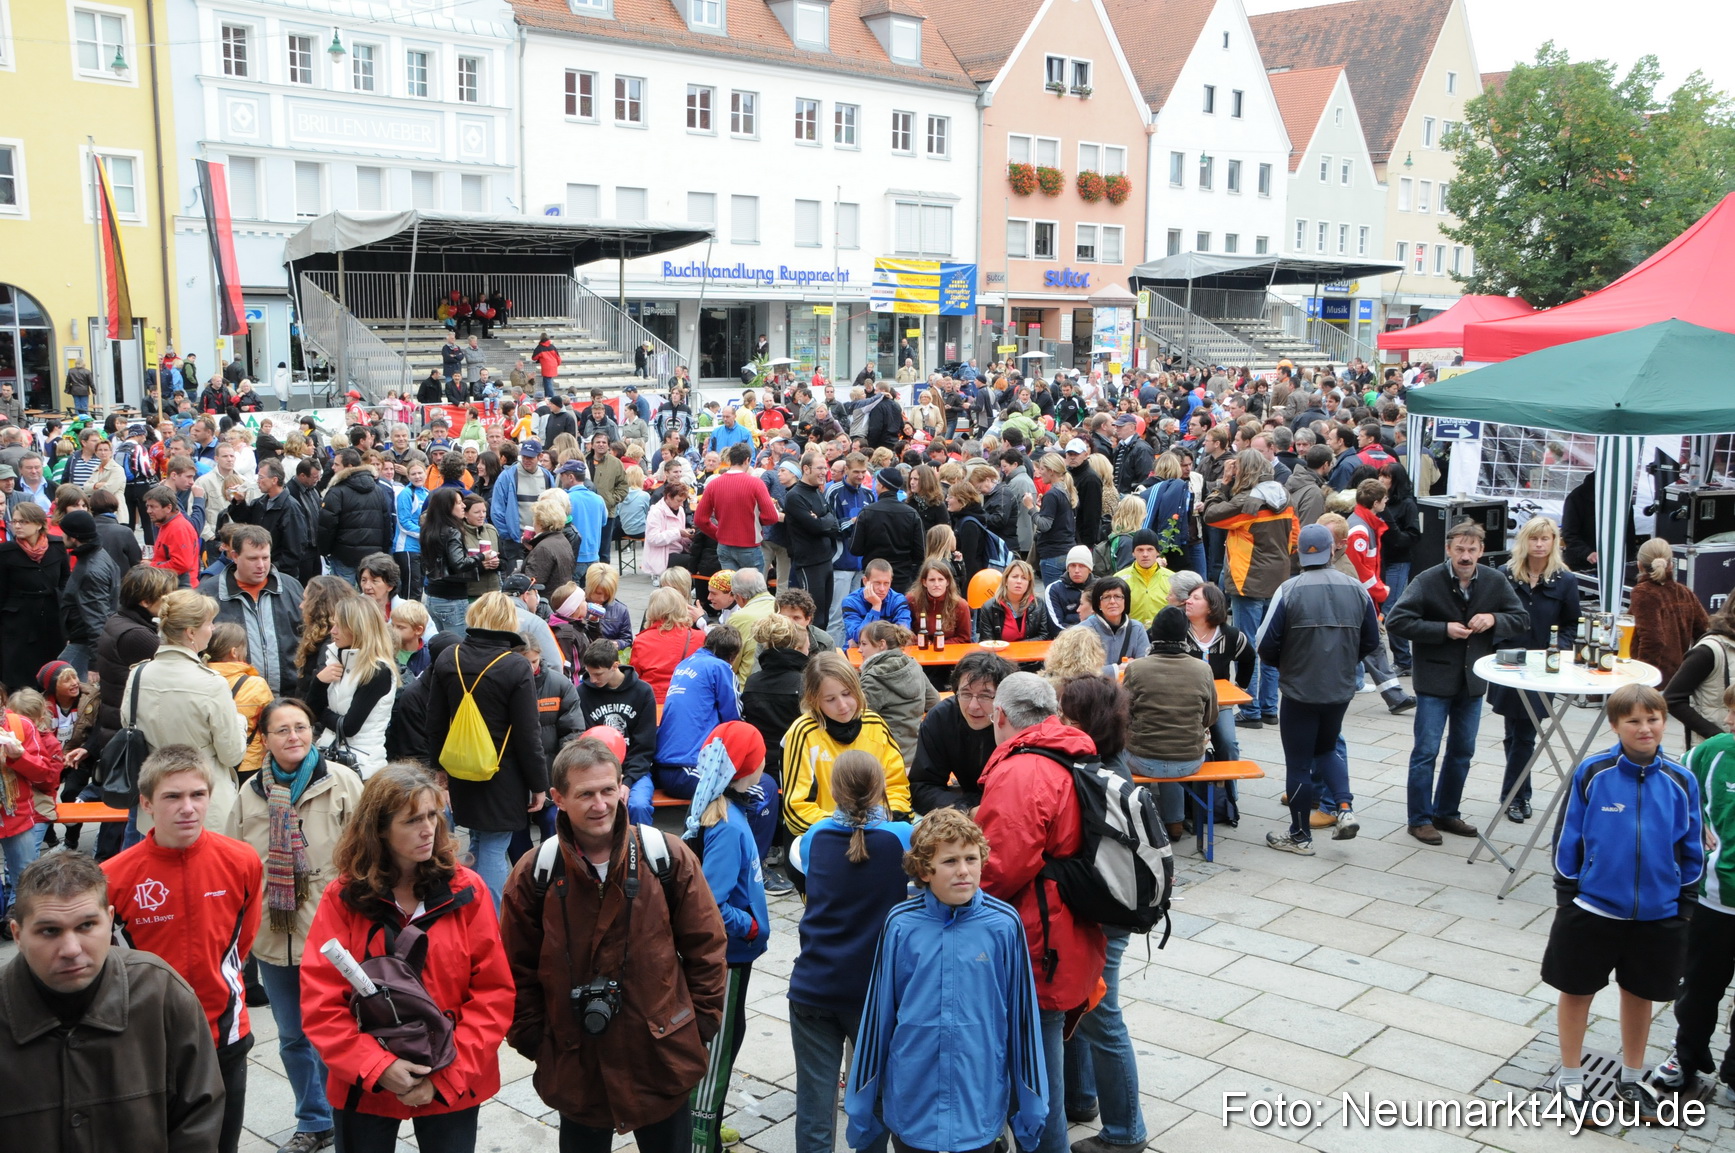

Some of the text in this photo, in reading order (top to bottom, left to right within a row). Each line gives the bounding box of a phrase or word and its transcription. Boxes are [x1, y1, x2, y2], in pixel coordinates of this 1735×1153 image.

[298, 113, 433, 143] BRILLEN WEBER
[663, 261, 850, 286] Buchhandlung Rupprecht
[651, 307, 677, 316] Rupprecht
[1326, 305, 1348, 314] Musik
[590, 703, 637, 722] HOHENFELS
[154, 913, 175, 923] Bayer
